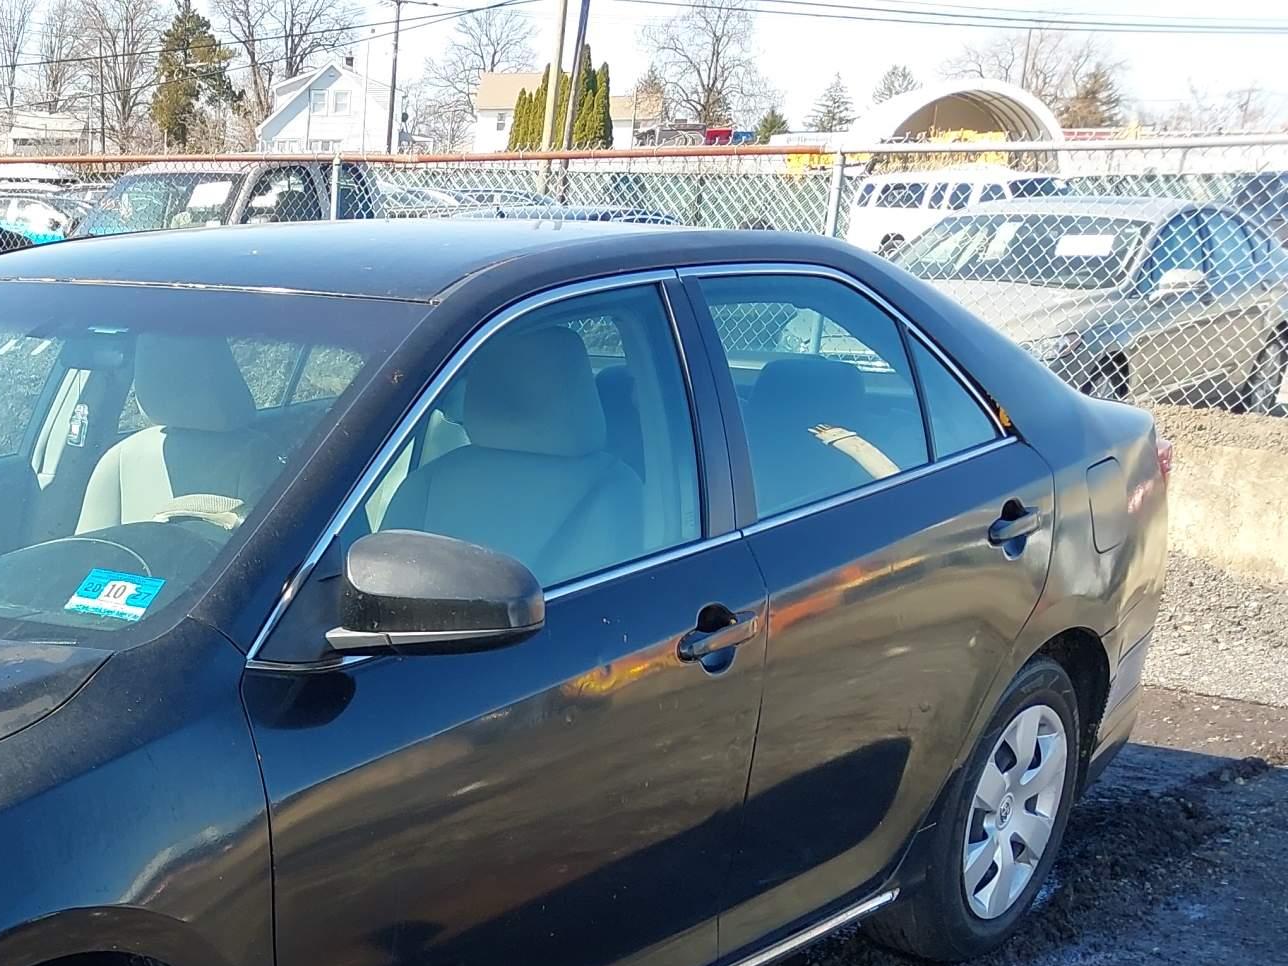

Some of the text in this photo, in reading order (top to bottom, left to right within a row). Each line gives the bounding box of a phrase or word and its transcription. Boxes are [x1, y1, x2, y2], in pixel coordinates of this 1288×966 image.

[83, 582, 152, 601] 20 10 27
